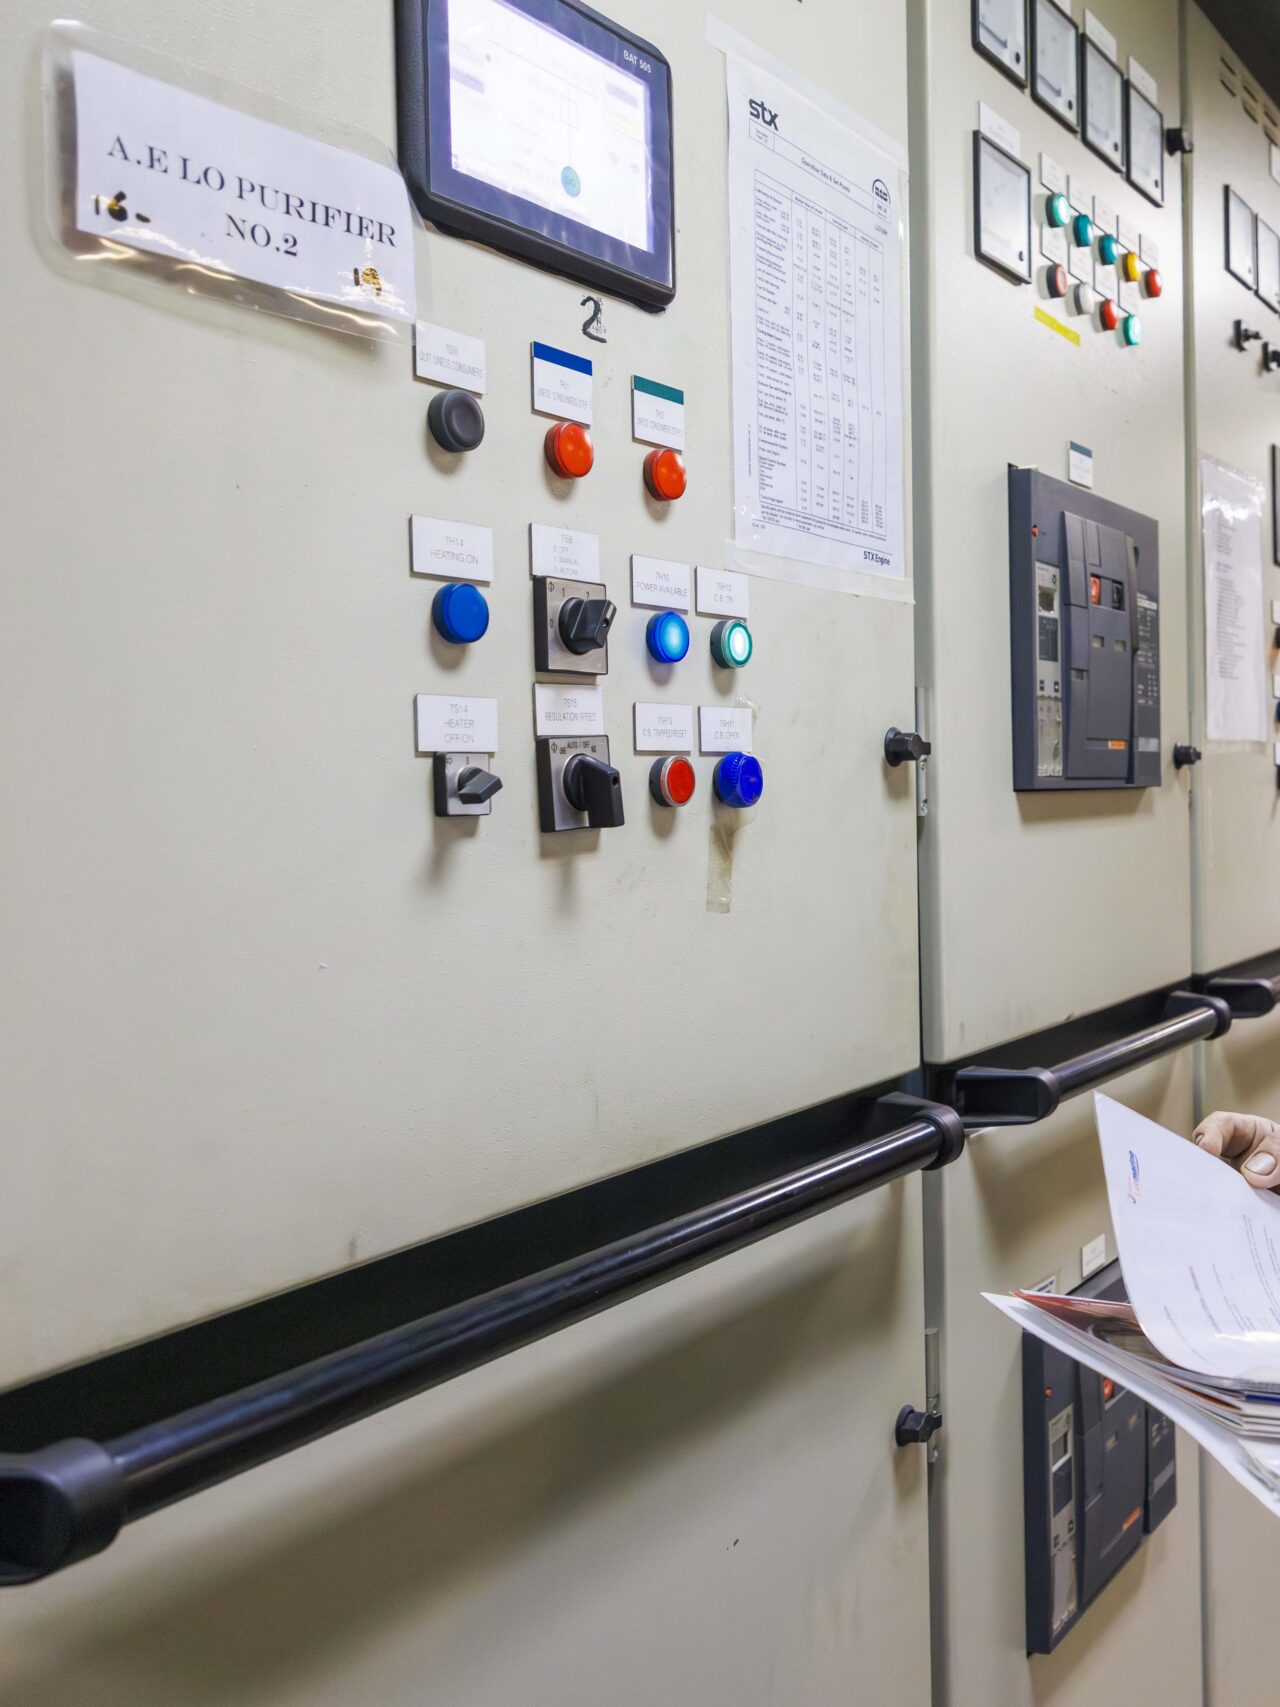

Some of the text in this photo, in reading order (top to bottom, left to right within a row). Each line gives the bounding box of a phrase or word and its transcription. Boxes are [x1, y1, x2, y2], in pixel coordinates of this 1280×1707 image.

[623, 50, 652, 74] BAT 505
[749, 98, 779, 131] stx
[107, 135, 397, 248] A.E LO PURIFIER
[225, 212, 299, 257] NO.2
[580, 295, 607, 344] 2
[430, 548, 479, 565] HEATING ON
[863, 550, 891, 566] STX Engine
[562, 587, 566, 598] 1
[636, 580, 689, 598] POWER AVAILABLE
[443, 718, 475, 729] HEATER
[544, 711, 597, 722] REGULATION SPEED
[567, 741, 578, 750] AUTO
